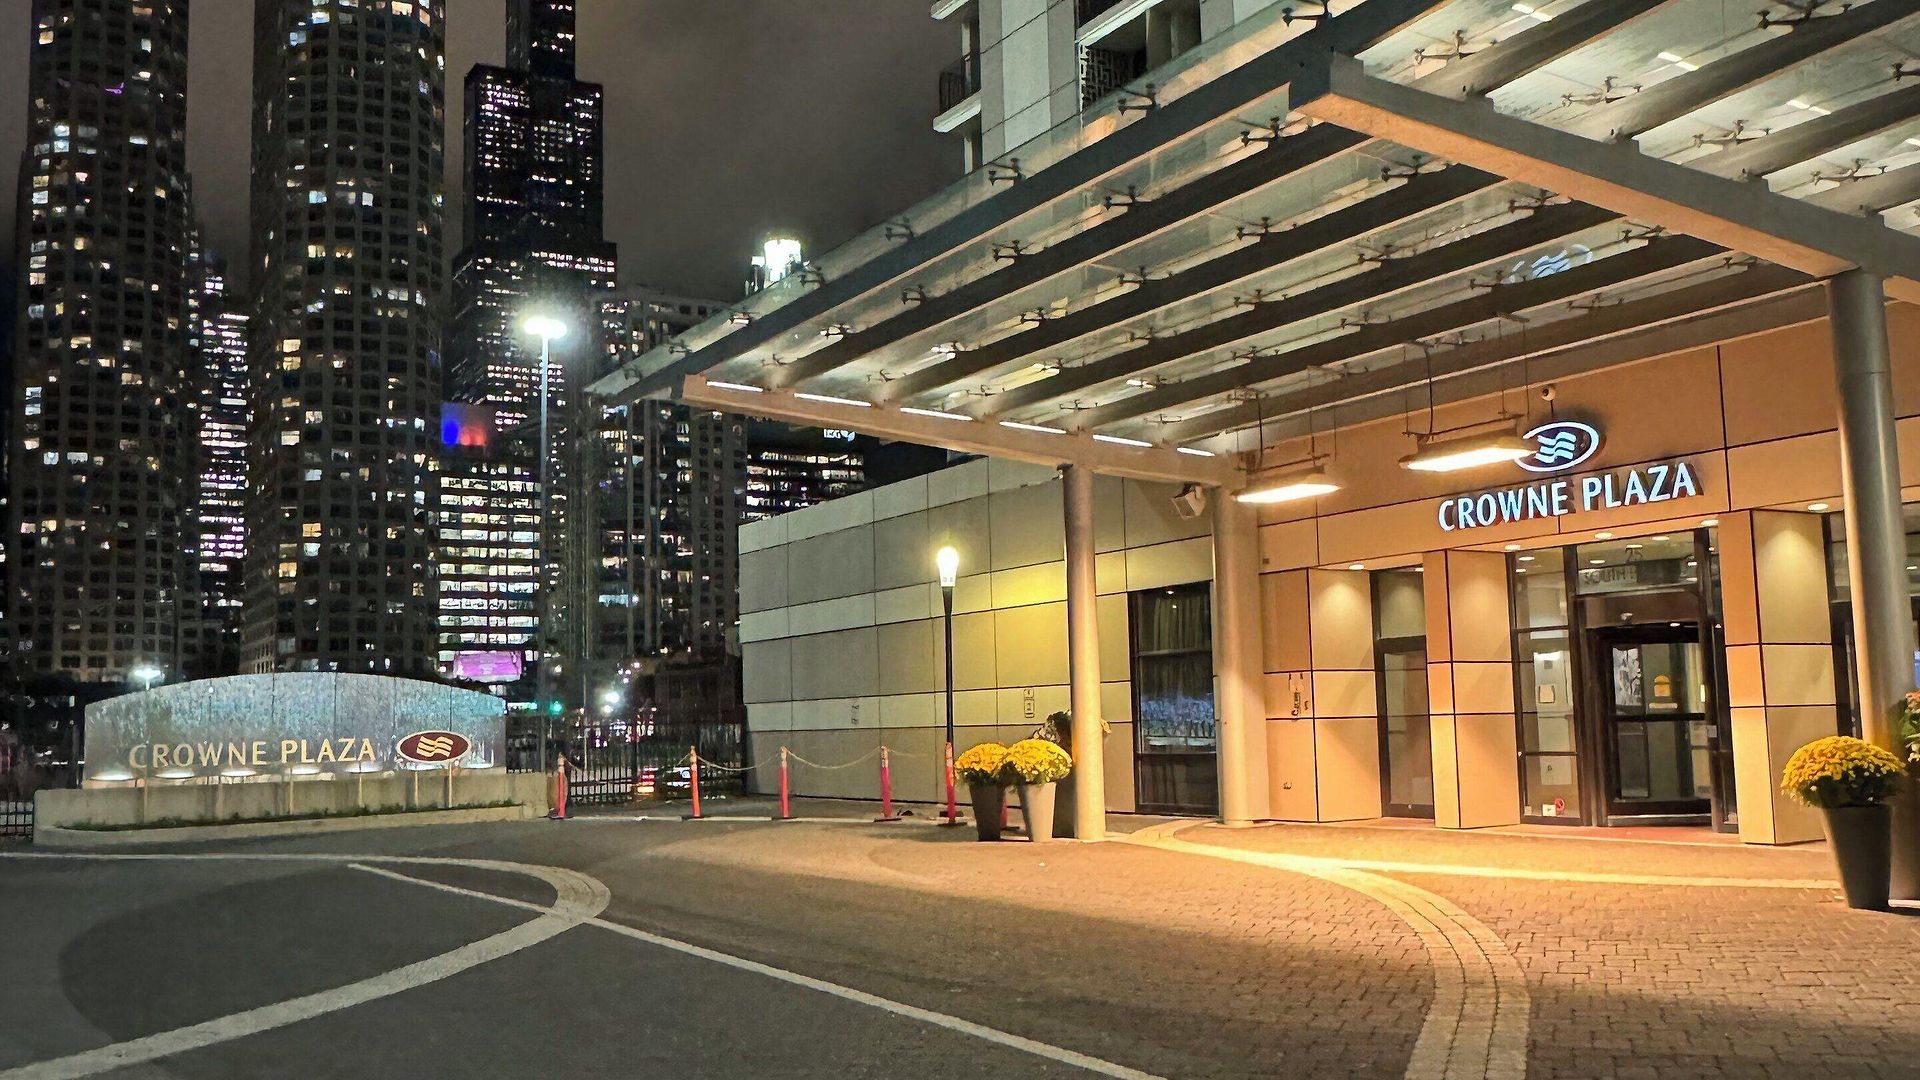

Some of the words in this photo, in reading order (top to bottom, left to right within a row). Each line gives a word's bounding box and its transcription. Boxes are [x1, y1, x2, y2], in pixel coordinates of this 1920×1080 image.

[1437, 481, 1570, 532] CROWNE
[1582, 462, 1698, 511] PLAZA
[129, 740, 268, 769] CROWNE
[280, 737, 376, 764] PLAZA
